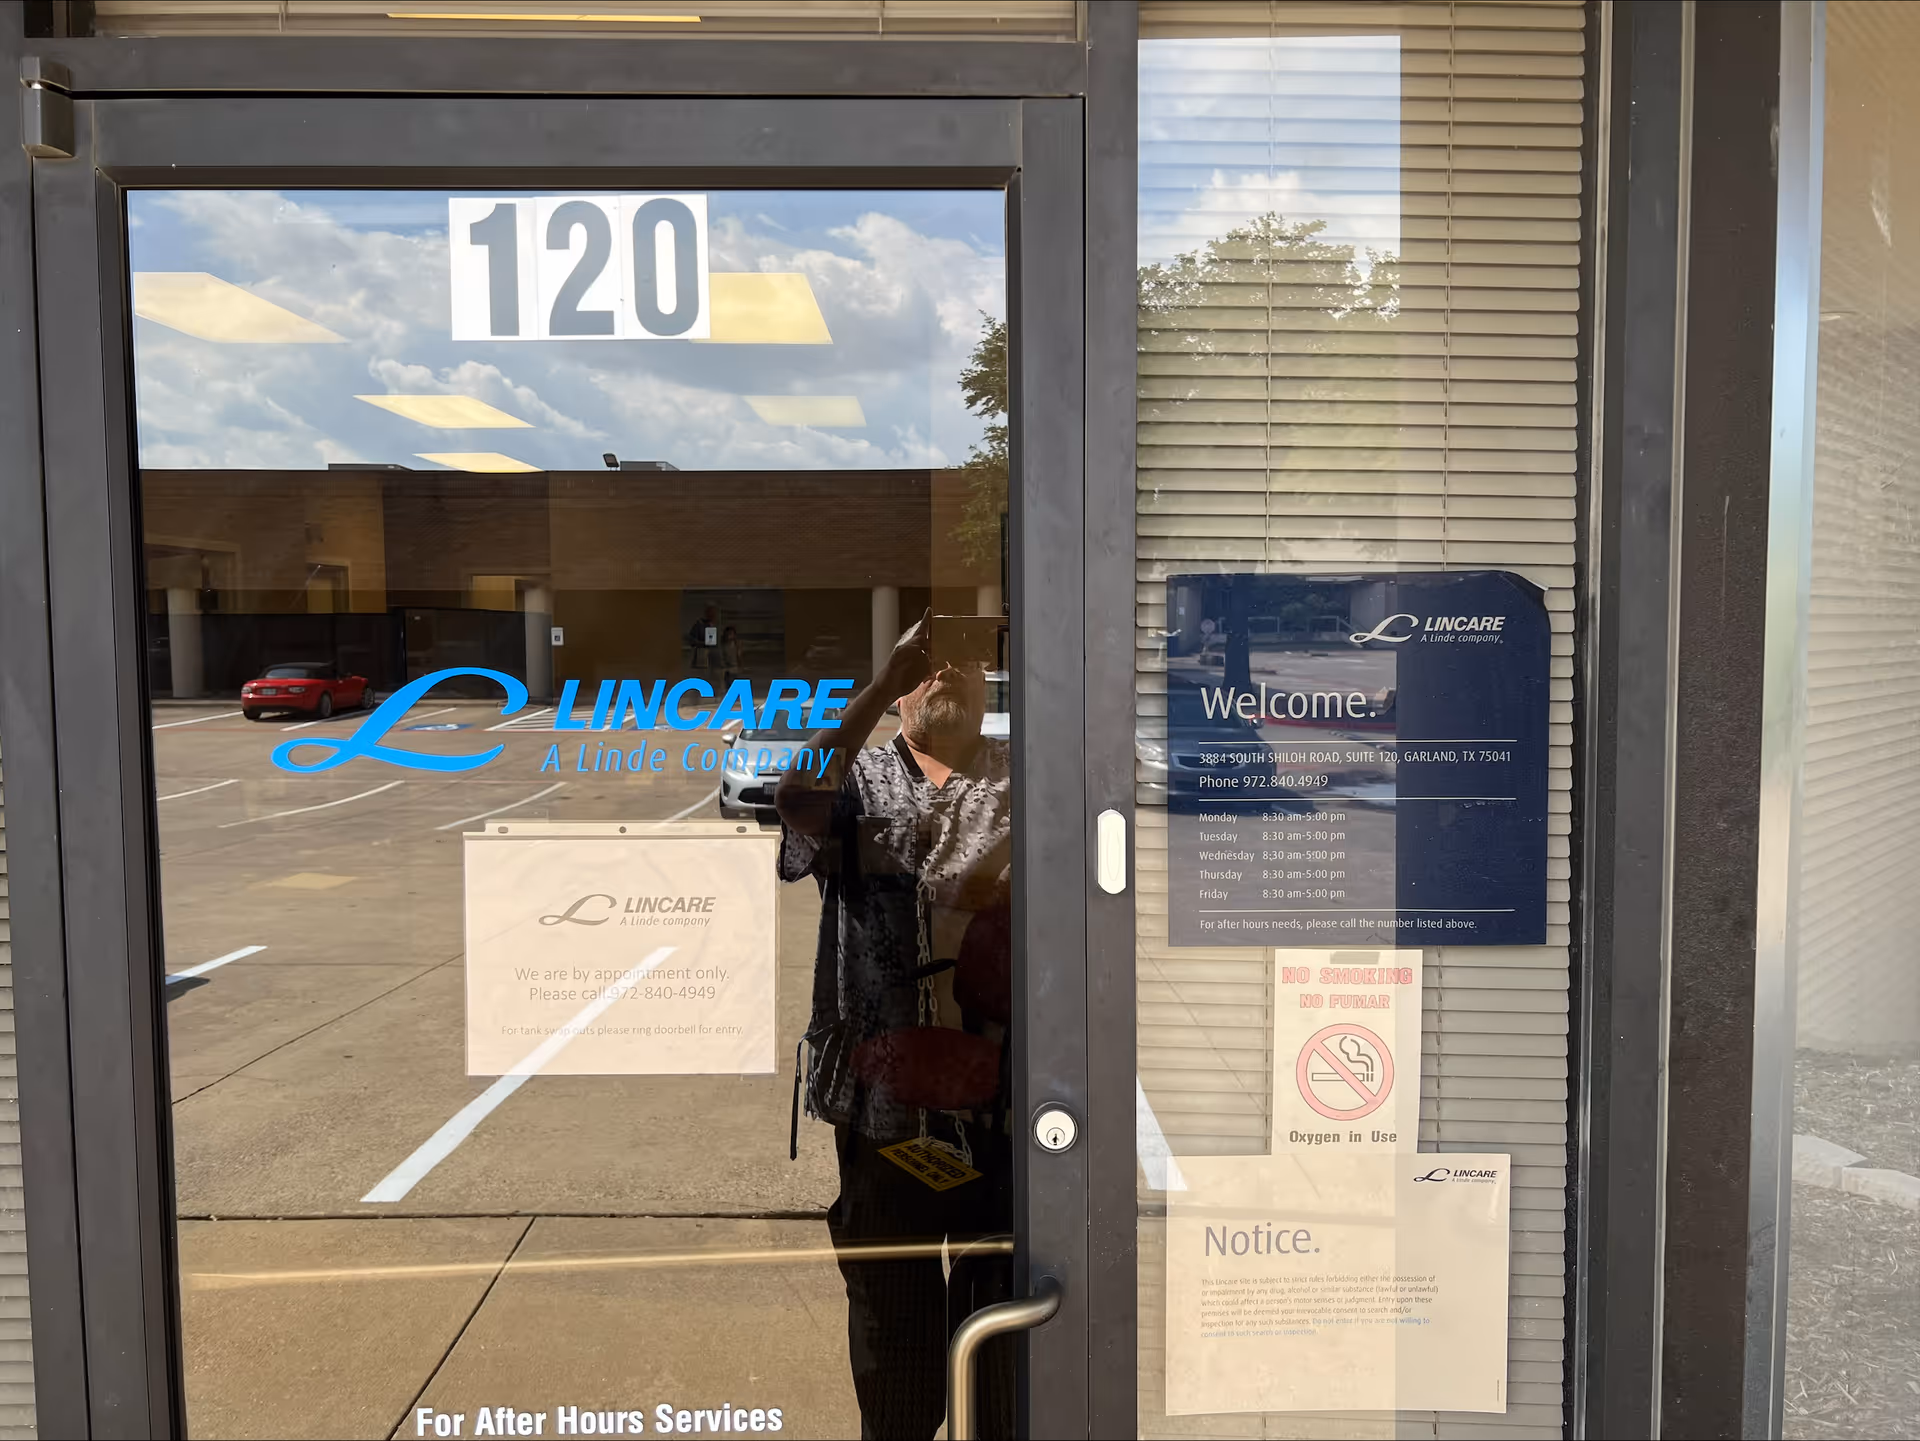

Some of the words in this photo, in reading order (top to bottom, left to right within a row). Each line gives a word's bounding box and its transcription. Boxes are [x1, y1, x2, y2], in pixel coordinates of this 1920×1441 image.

[470, 198, 699, 336] 120
[1424, 616, 1506, 632] LINCARE
[1420, 635, 1427, 643] A
[1430, 634, 1456, 643] Linde
[553, 678, 855, 730] LINCARE
[1200, 682, 1377, 720] Welcome.
[540, 744, 560, 772] A
[577, 740, 666, 772] Linde
[682, 743, 834, 778] Company
[1199, 753, 1226, 764] 3884
[1230, 752, 1265, 763] SOUTH
[1268, 752, 1306, 763] SHILOH
[1310, 752, 1342, 765] ROAD,
[1346, 751, 1374, 763] SUITE
[1379, 751, 1400, 764] 120,
[1404, 751, 1459, 763] GARLAND,
[1462, 751, 1475, 762] TX
[1479, 751, 1511, 762] 75041
[1199, 775, 1238, 788] Phone
[1243, 775, 1329, 788] 972.840.4949
[1199, 812, 1238, 824] Monday
[1262, 812, 1284, 822] 8:30
[1287, 812, 1327, 822] am-5:00
[1330, 813, 1346, 823] pm
[1199, 831, 1238, 843] Tuesday
[1262, 831, 1284, 841] 8:30
[1287, 831, 1327, 841] am-5:00
[1330, 832, 1346, 842] pm
[1199, 850, 1255, 862] Wednesday
[1262, 850, 1284, 860] 8:30
[1287, 850, 1327, 860] am-5:00
[1330, 851, 1346, 861] pm
[1199, 869, 1242, 881] Thursday
[1262, 869, 1284, 879] 8:30
[1287, 869, 1327, 879] am-5:00
[1330, 870, 1346, 880] pm
[1199, 889, 1228, 901] Friday
[1262, 889, 1284, 899] 8:30
[1287, 889, 1327, 899] am-5:00
[1330, 890, 1346, 900] pm
[624, 896, 716, 914] LINCARE
[619, 917, 627, 926] A
[630, 915, 659, 926] Linde
[662, 917, 711, 928] company
[1200, 920, 1214, 929] For
[1217, 919, 1240, 929] after
[1242, 919, 1269, 929] hours
[1272, 919, 1303, 930] needs,
[1306, 919, 1337, 930] please
[1340, 918, 1356, 928] call
[1359, 918, 1375, 928] the
[1377, 918, 1414, 928] number
[1417, 918, 1442, 929] listed
[1445, 918, 1477, 929] above.
[515, 967, 539, 980] We
[544, 970, 568, 980] are
[573, 967, 590, 983] by
[594, 967, 691, 983] appointment
[696, 966, 730, 982] only.
[1282, 967, 1310, 984] NO
[1319, 968, 1413, 985] SMOKING
[529, 987, 577, 1001] Please
[581, 986, 606, 1000] call
[610, 986, 716, 1000] 972-840-4949
[1300, 994, 1323, 1008] NO
[1329, 994, 1390, 1009] FUMAR
[501, 1025, 517, 1035] For
[520, 1025, 542, 1035] tank
[597, 1025, 630, 1037] please
[632, 1025, 652, 1036] ring
[654, 1024, 696, 1035] doorbell
[699, 1024, 712, 1035] for
[1289, 1131, 1340, 1145] Oxygen
[1349, 1131, 1361, 1142] in
[1371, 1131, 1397, 1143] Use
[1453, 1169, 1497, 1178] LINCARE
[1205, 1222, 1320, 1257] Notice.
[417, 1407, 465, 1436] For
[474, 1406, 547, 1436] After
[557, 1405, 644, 1435] Hours
[655, 1403, 783, 1434] Services
